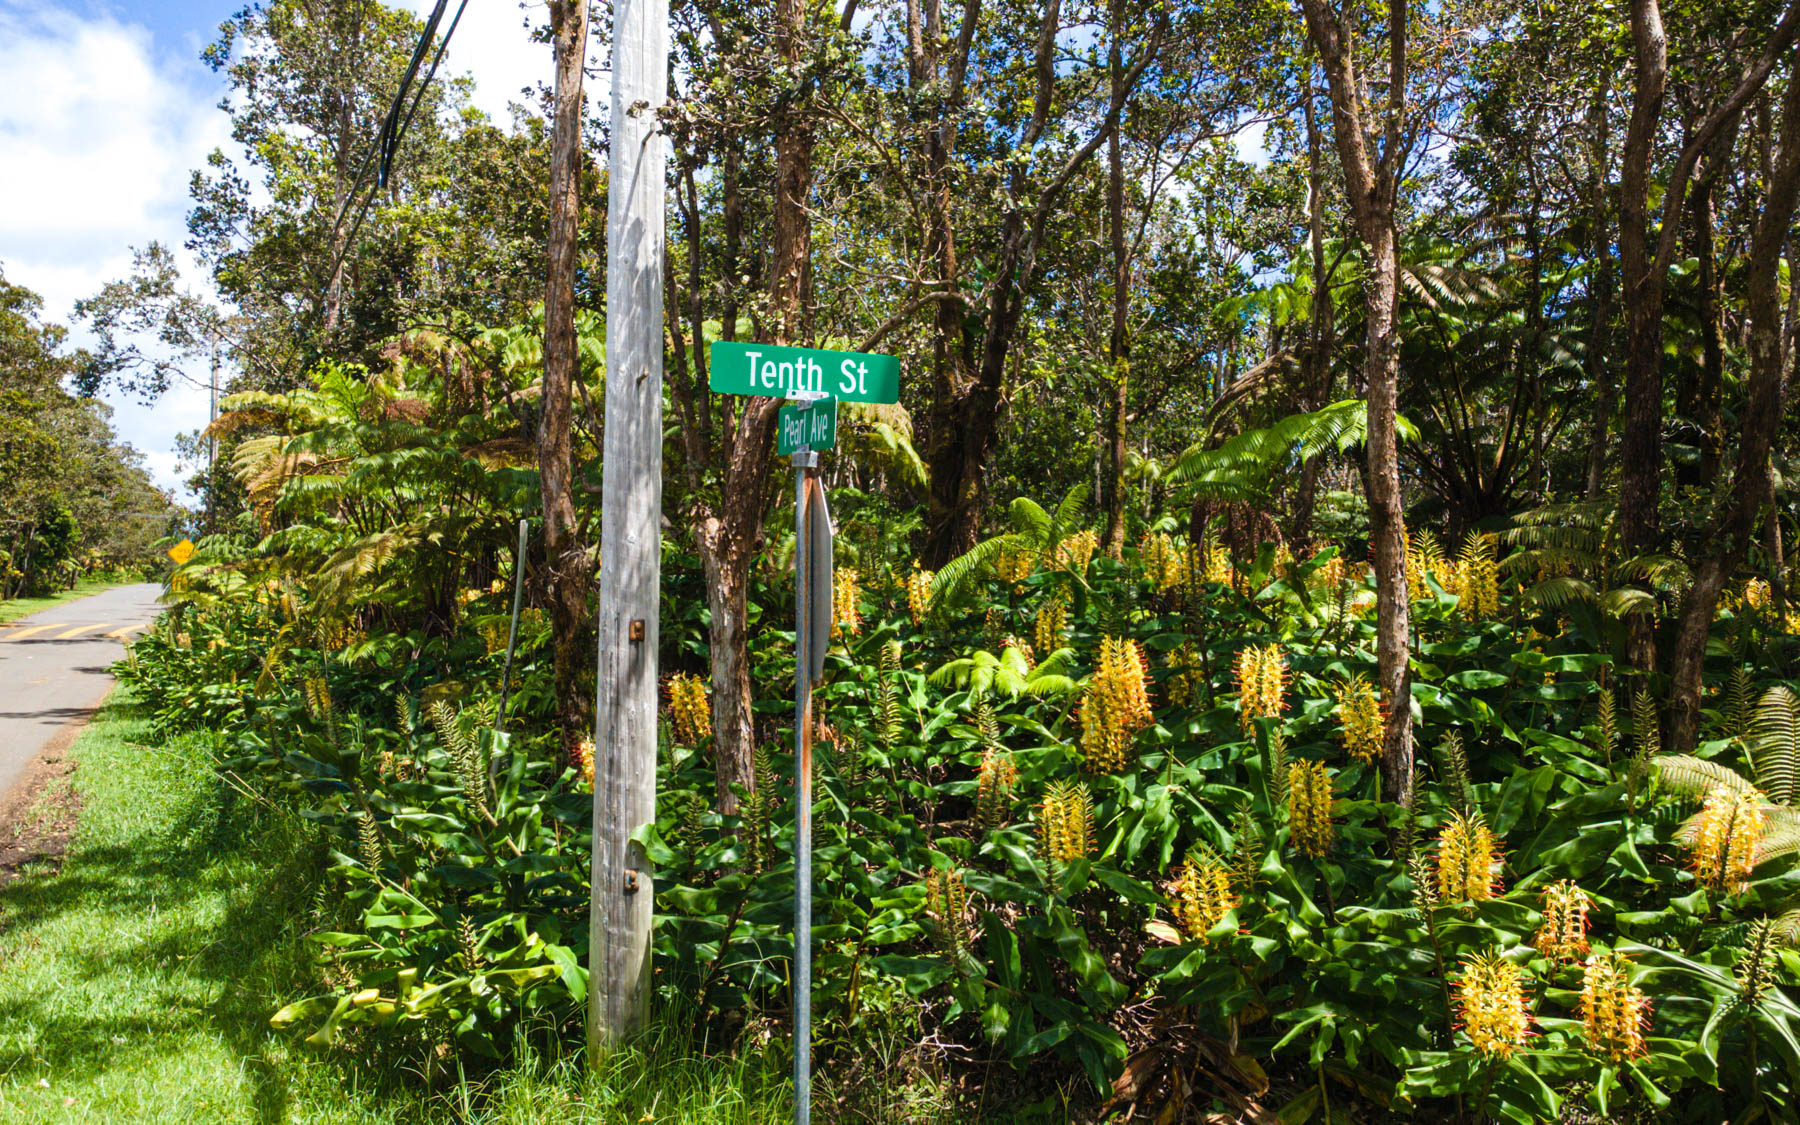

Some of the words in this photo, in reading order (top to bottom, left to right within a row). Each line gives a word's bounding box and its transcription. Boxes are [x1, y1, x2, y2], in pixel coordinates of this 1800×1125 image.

[745, 352, 822, 391] Tenth
[839, 359, 868, 394] St
[784, 410, 806, 447] Pearl
[810, 408, 828, 443] Ave
